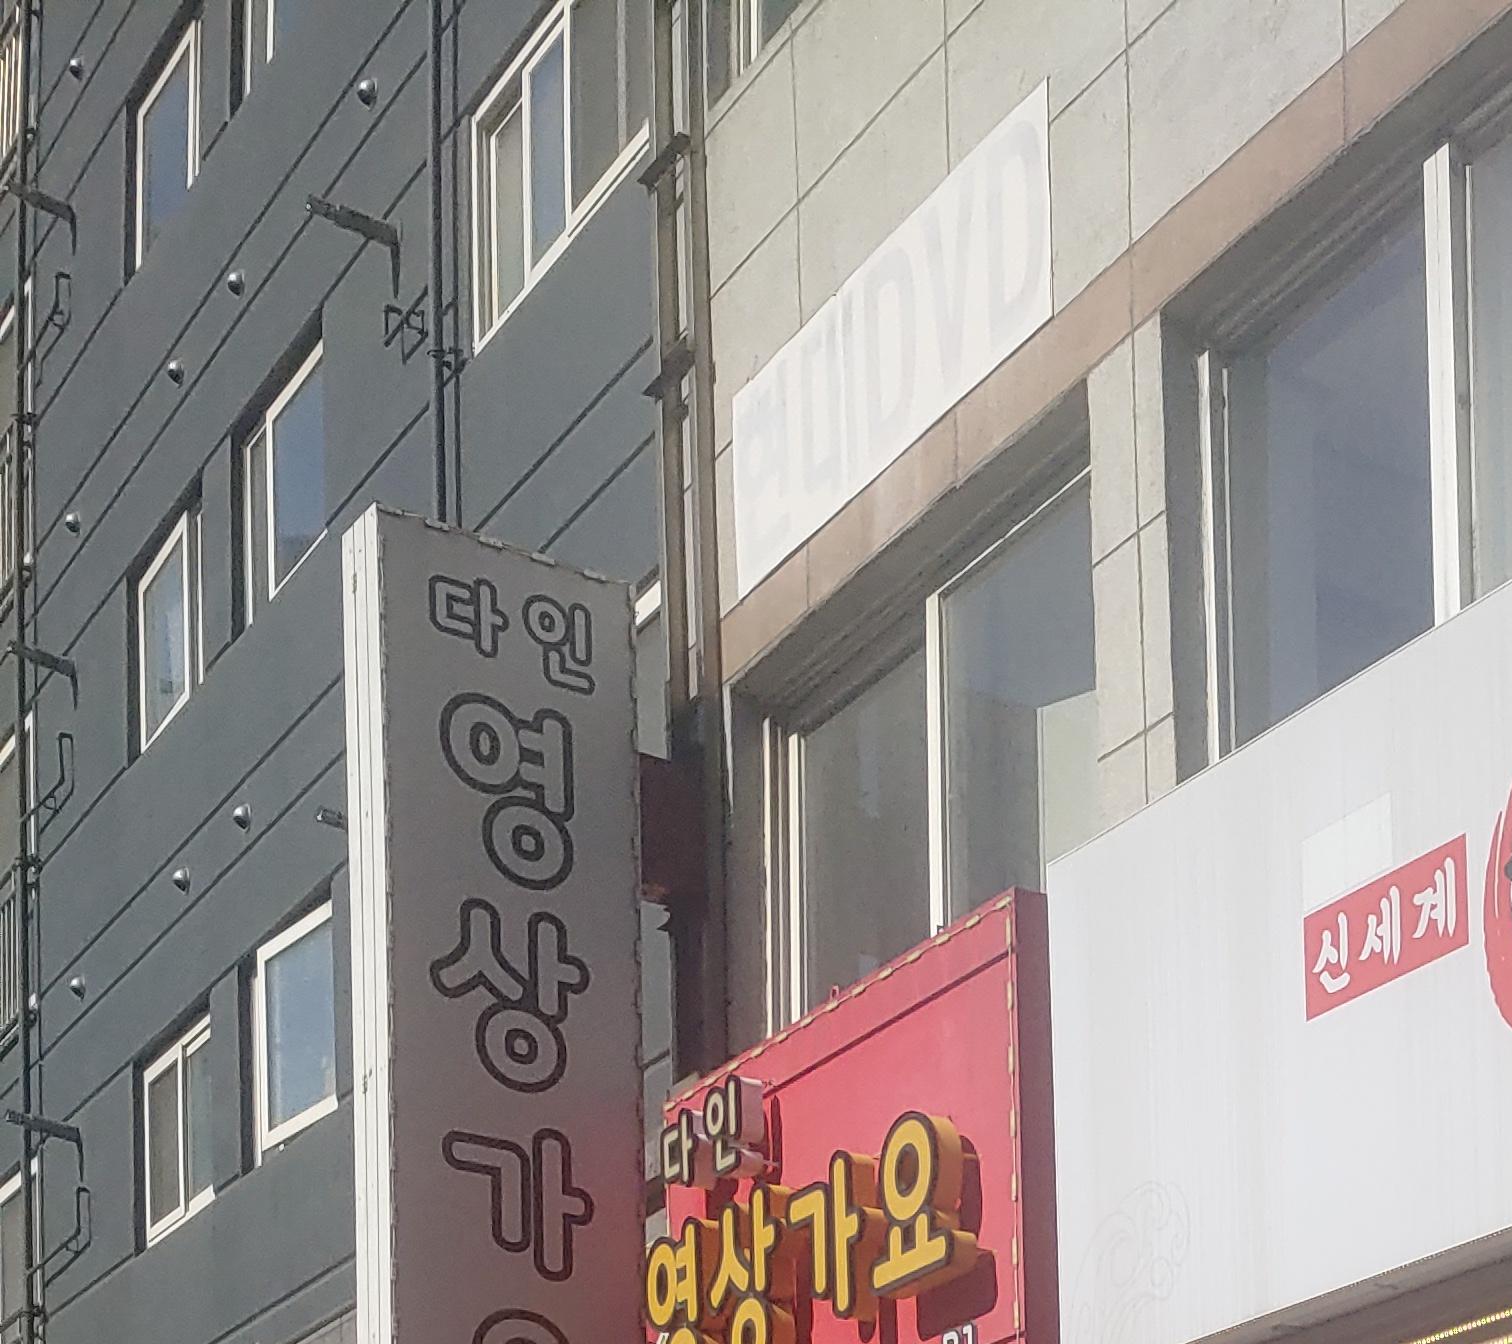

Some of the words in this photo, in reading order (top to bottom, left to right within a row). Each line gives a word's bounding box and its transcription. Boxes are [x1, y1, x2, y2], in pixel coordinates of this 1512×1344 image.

[429, 573, 595, 695] 다인
[1312, 854, 1457, 994] 신세계
[661, 1074, 741, 1185] 다인
